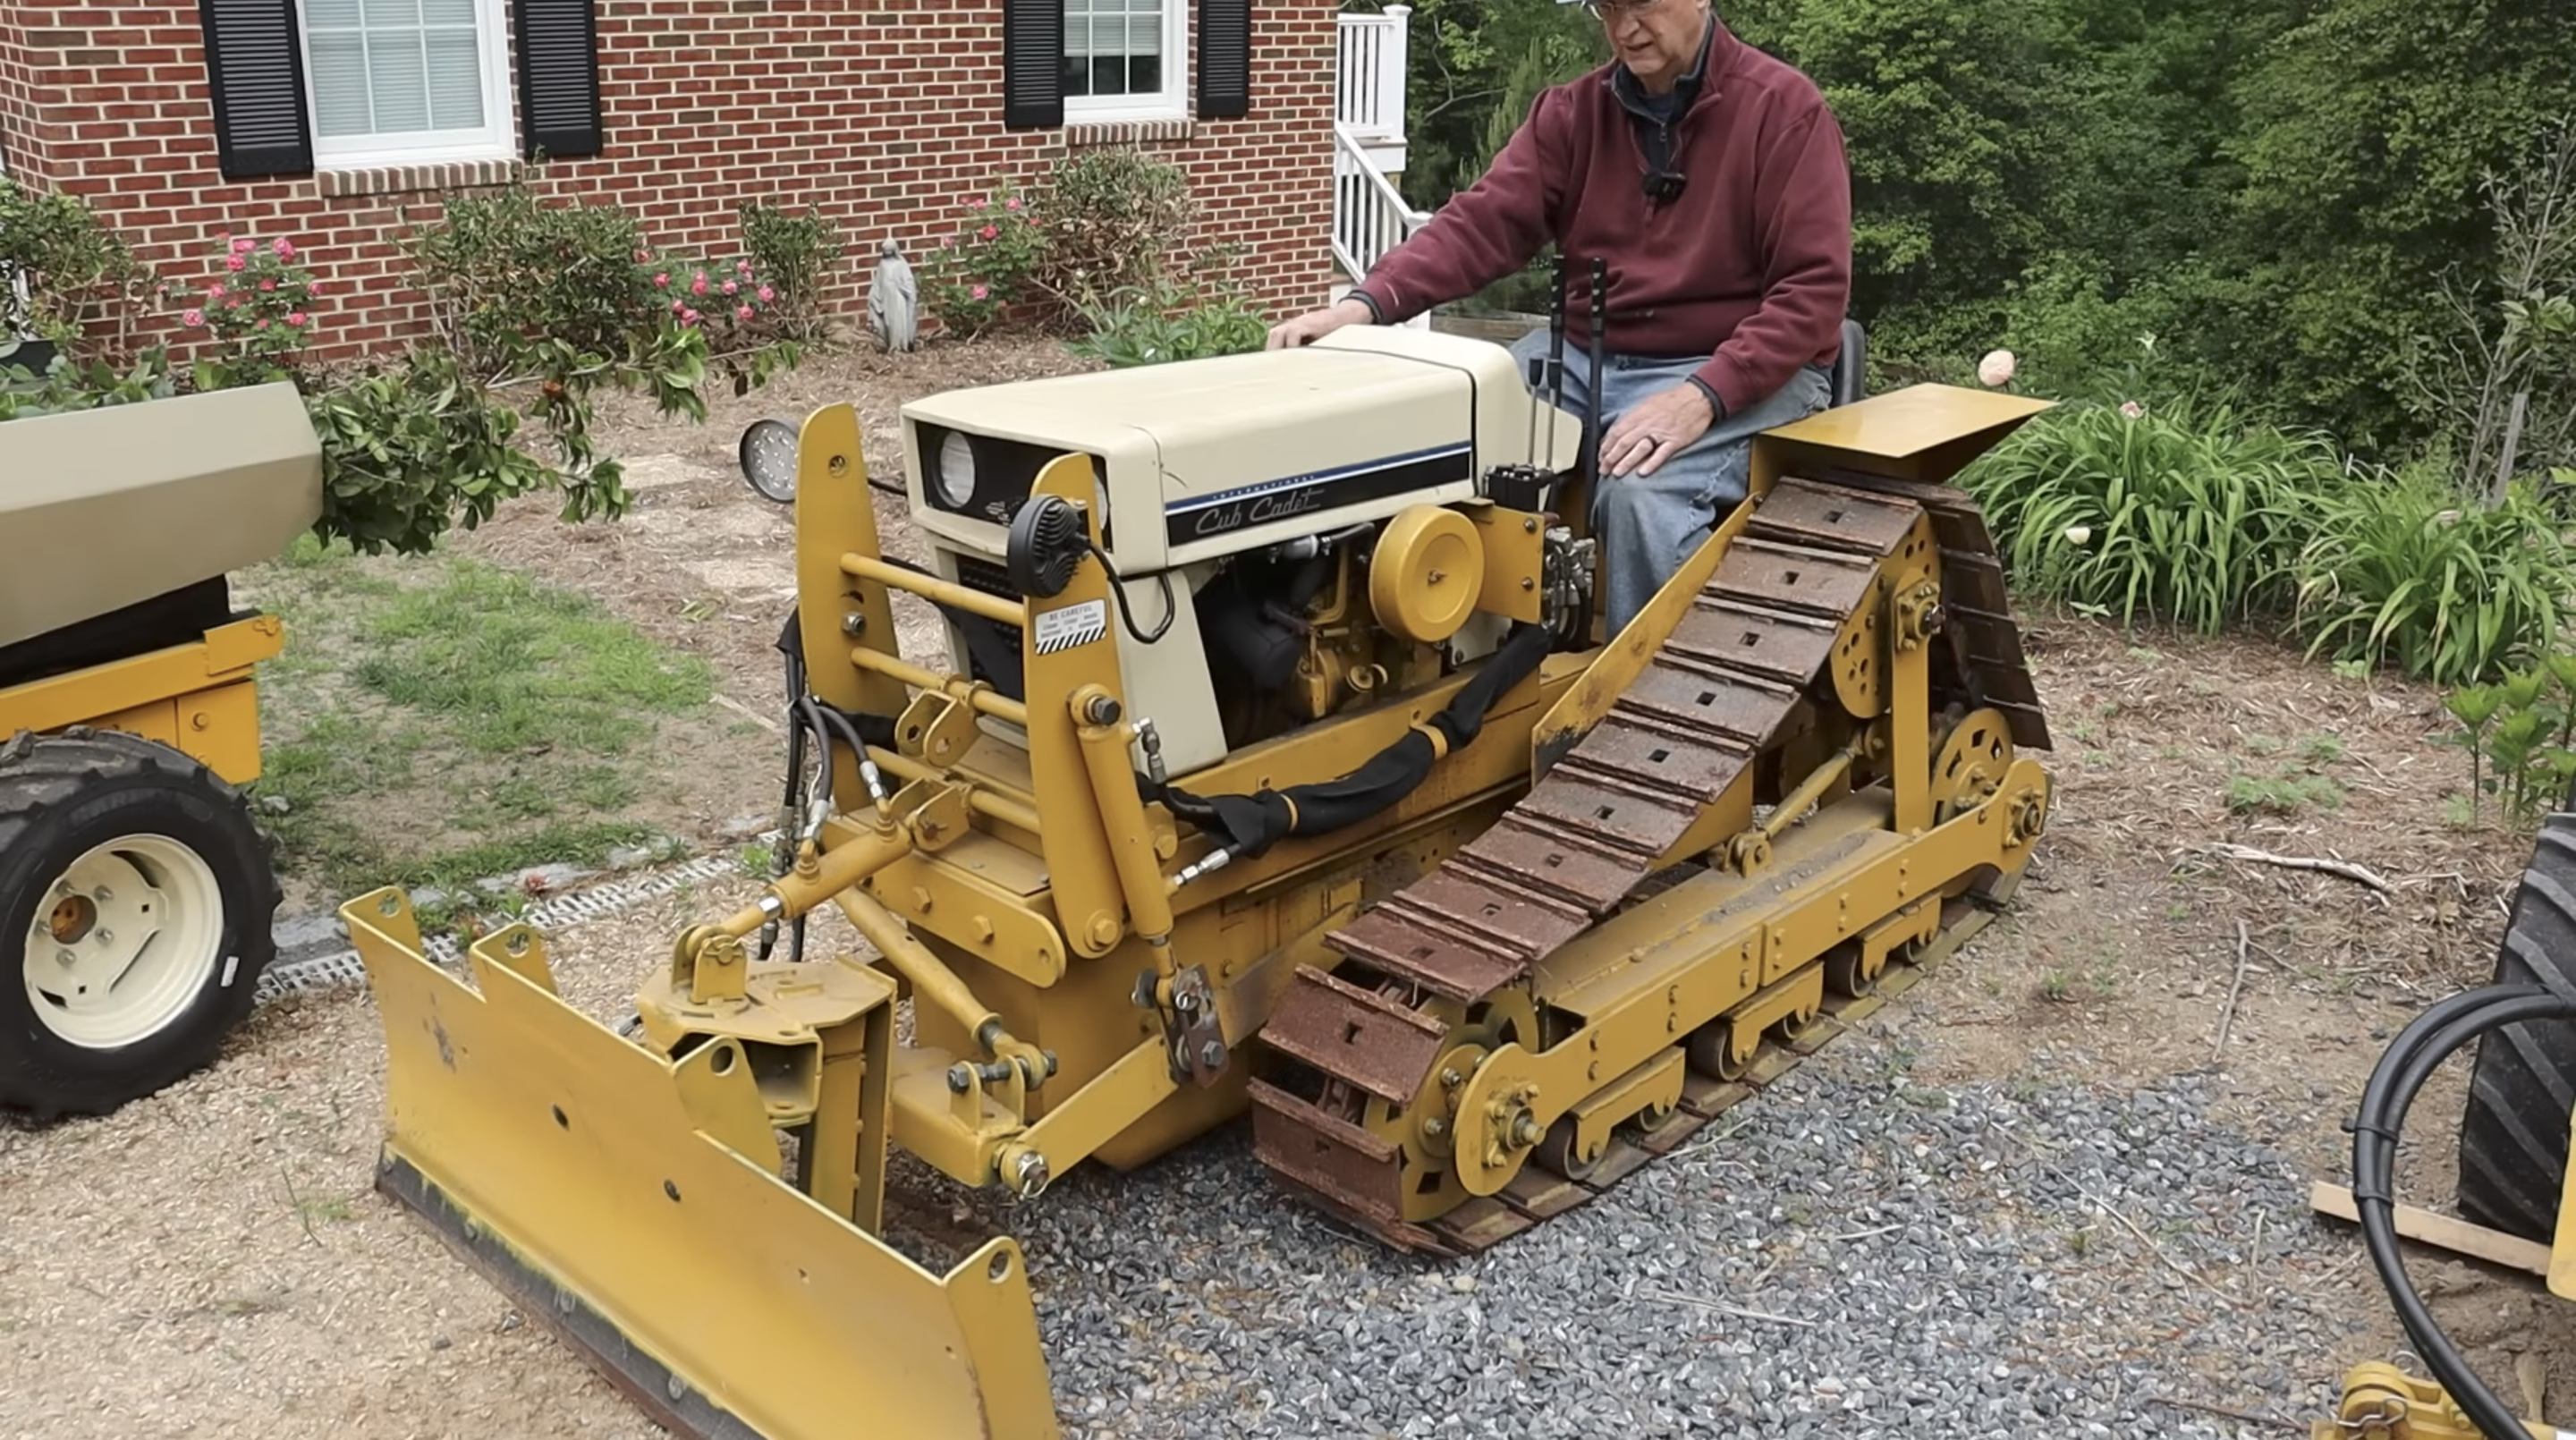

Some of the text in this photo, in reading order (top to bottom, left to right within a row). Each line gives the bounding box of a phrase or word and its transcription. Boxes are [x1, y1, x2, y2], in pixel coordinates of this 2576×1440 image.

[1195, 487, 1325, 534] Cub Cadet
[1049, 612, 1058, 622] BE
[1060, 605, 1093, 619] CAREFUL
